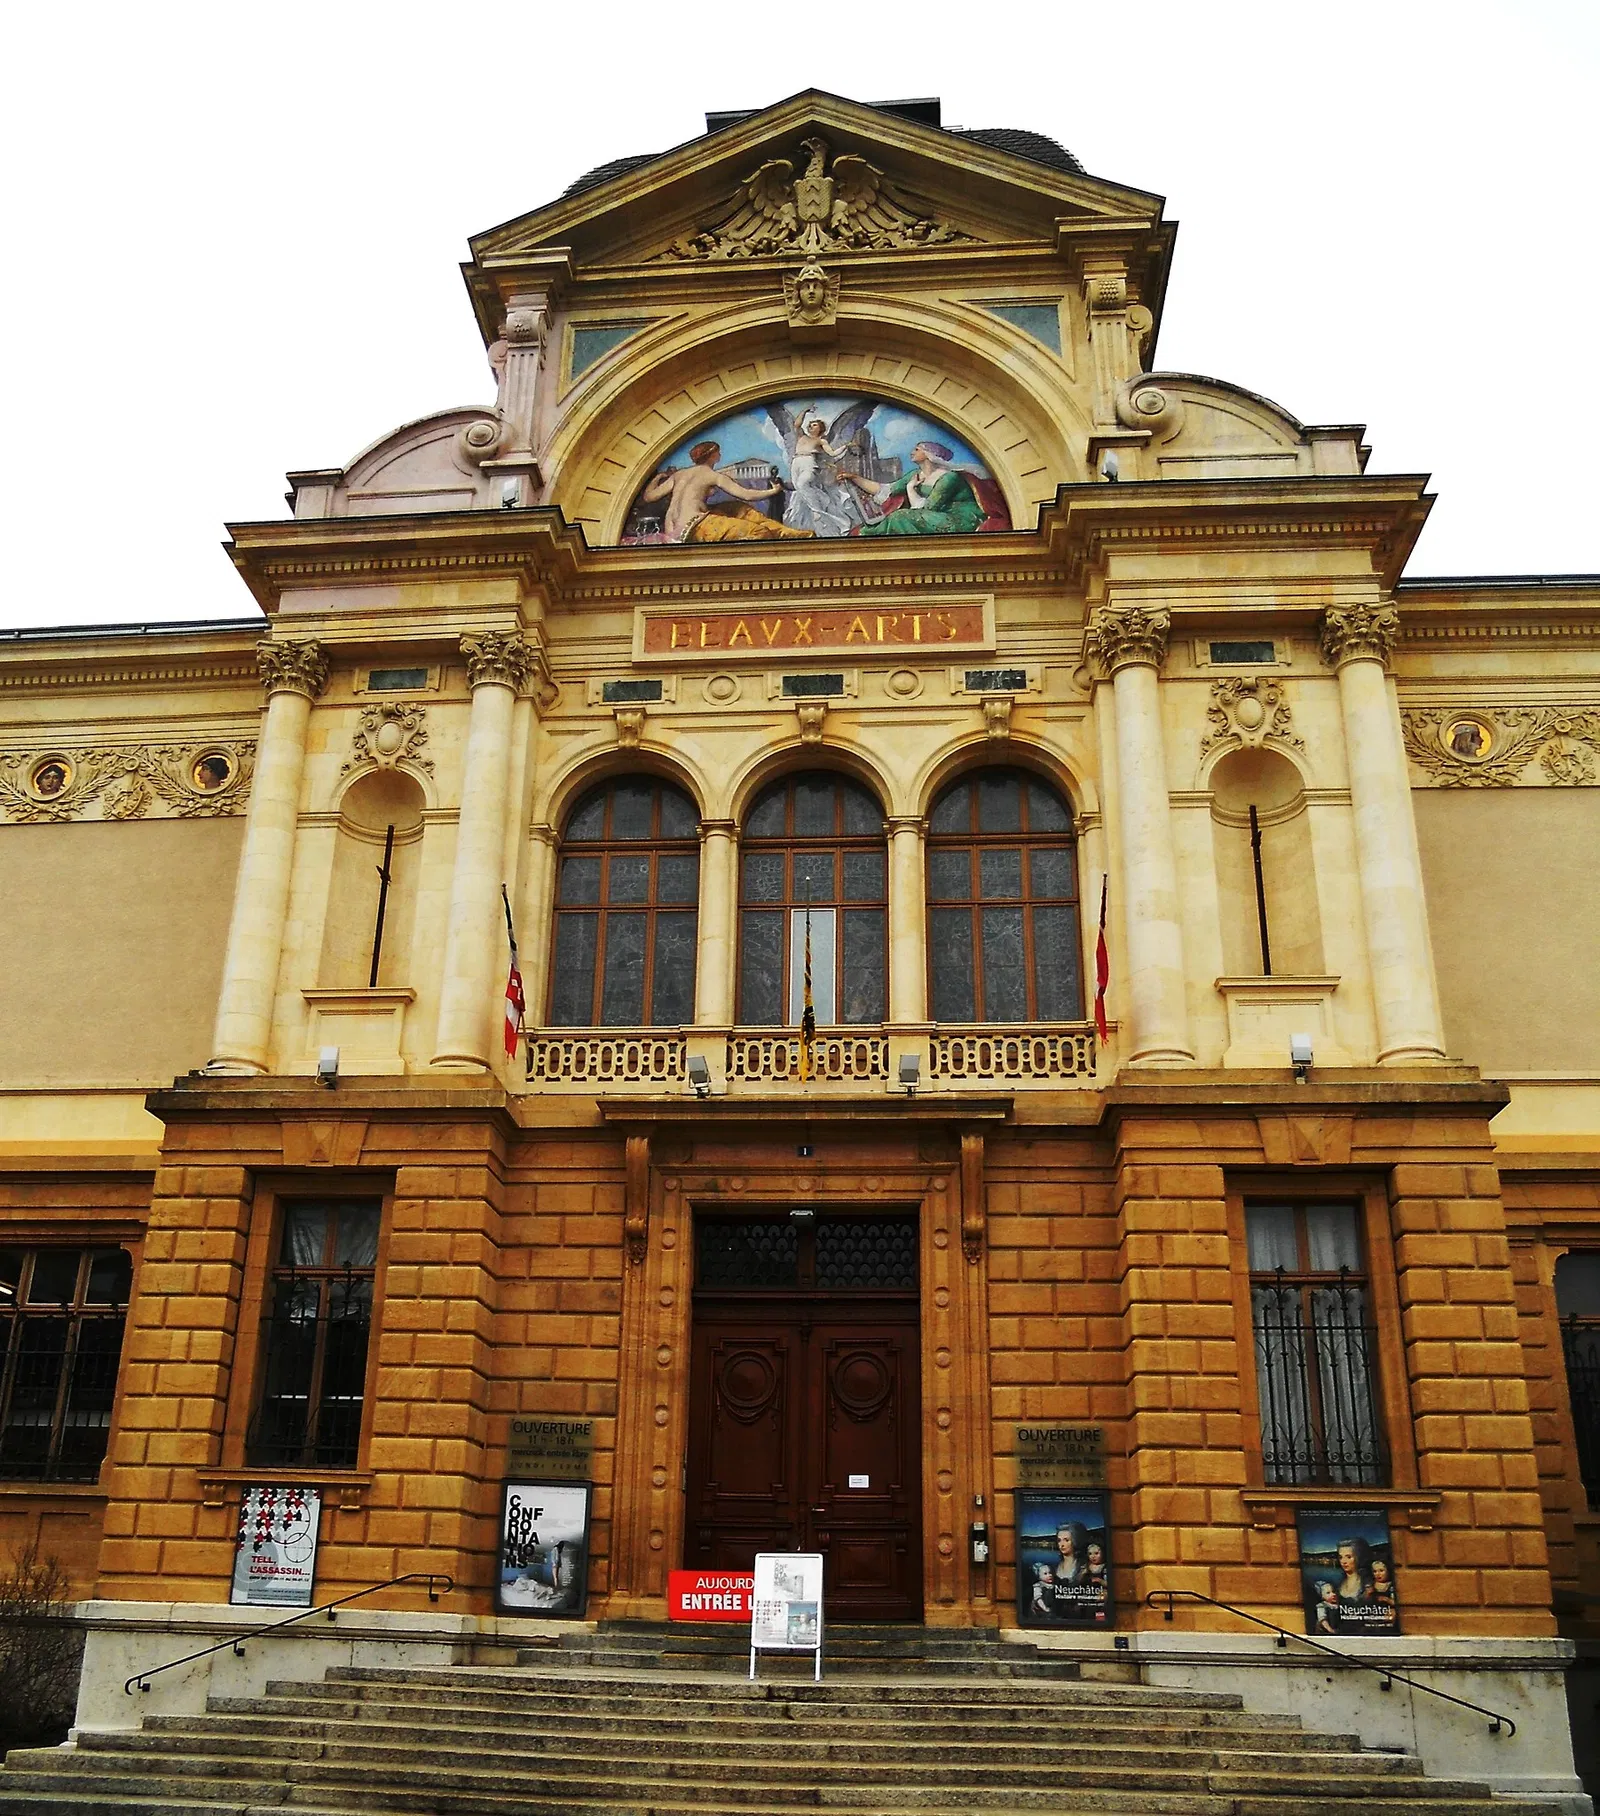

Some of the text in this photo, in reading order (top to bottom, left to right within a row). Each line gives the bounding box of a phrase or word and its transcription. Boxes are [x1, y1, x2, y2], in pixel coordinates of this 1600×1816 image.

[513, 1421, 591, 1435] OUVERTURE
[1018, 1429, 1101, 1441] OUVERTURE
[509, 1507, 544, 1520] ONF
[251, 1556, 277, 1564] TELL,
[1055, 1585, 1104, 1595] Neuchâtel
[681, 1590, 742, 1610] ENTRÉE
[1340, 1605, 1392, 1615] Neuchâtel
